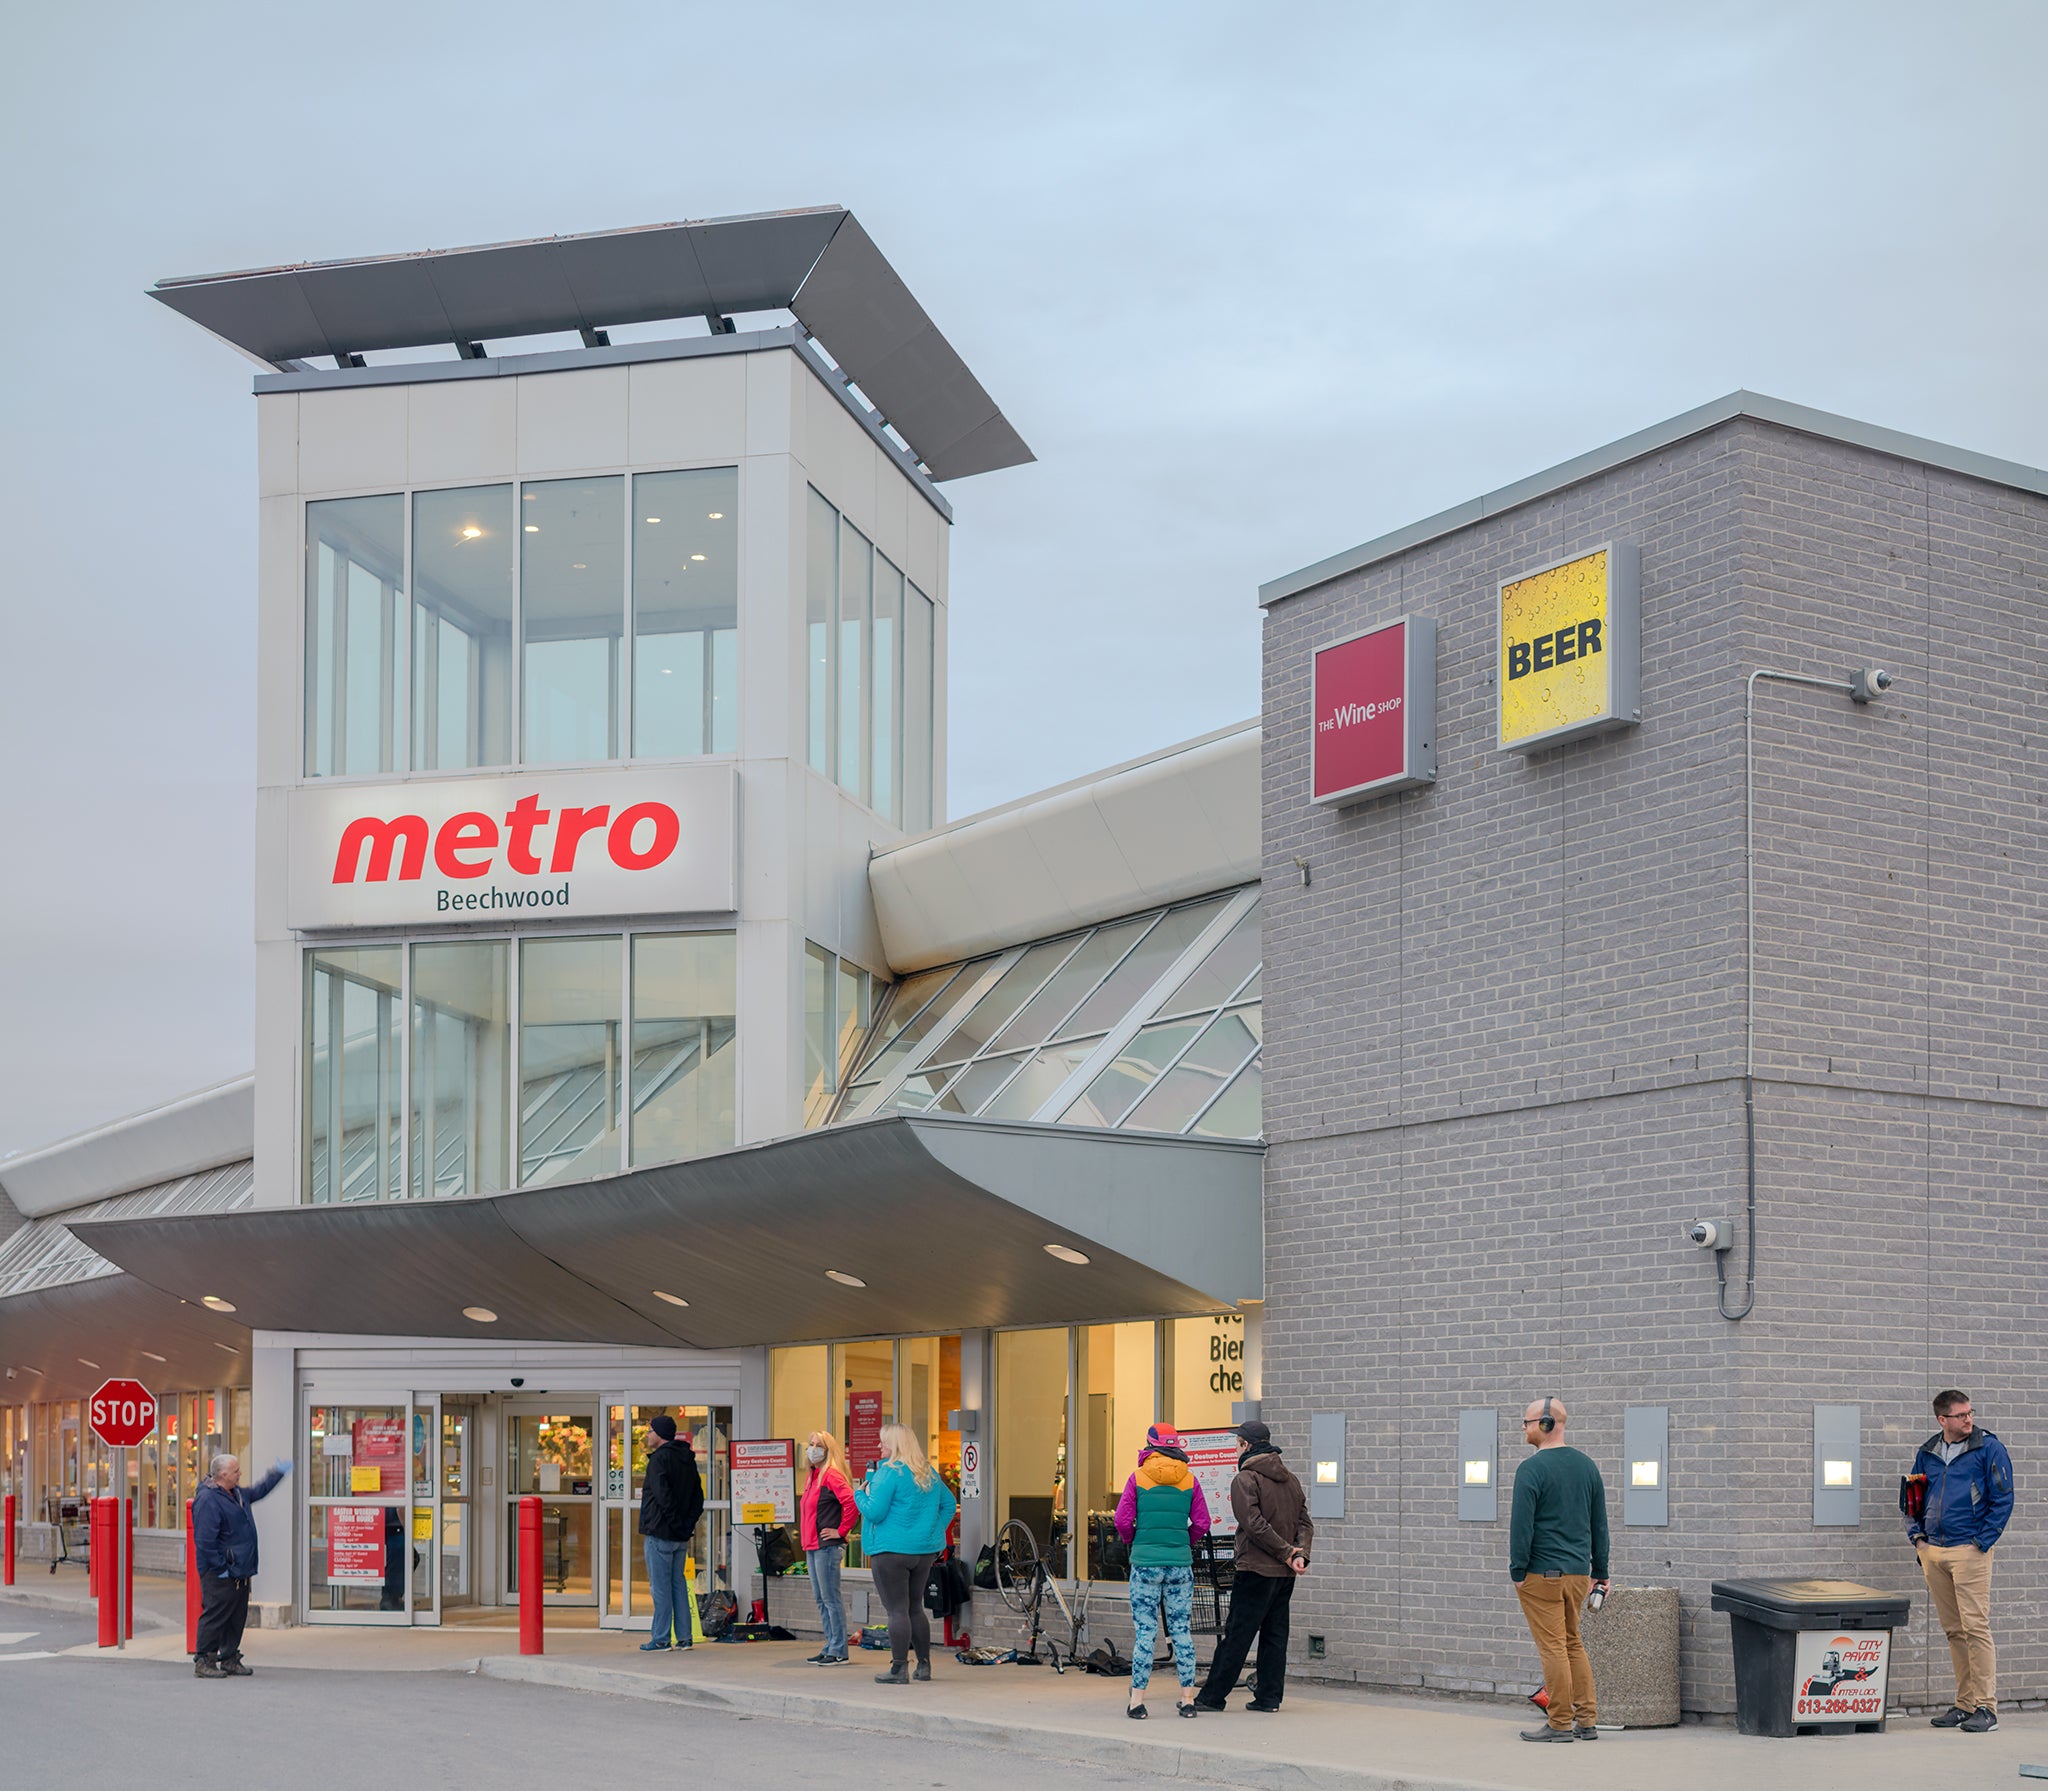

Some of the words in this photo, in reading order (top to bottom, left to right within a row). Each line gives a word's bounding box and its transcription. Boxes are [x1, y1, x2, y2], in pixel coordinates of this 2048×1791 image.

[1508, 618, 1602, 681] BEER
[1318, 718, 1334, 733] THE
[1334, 703, 1376, 729] Wine
[1377, 697, 1401, 714] SHOP
[332, 793, 680, 884] metro
[436, 882, 570, 911] Beechwood
[1210, 1364, 1244, 1393] che
[92, 1399, 153, 1427] STOP
[315, 1414, 325, 1431] 2
[1219, 1451, 1238, 1459] Count
[1858, 1640, 1883, 1650] CITY
[1842, 1651, 1880, 1661] PAVING
[1854, 1667, 1868, 1682] &
[1859, 1688, 1879, 1696] LOCK
[1797, 1698, 1882, 1714] 613-266-0327
